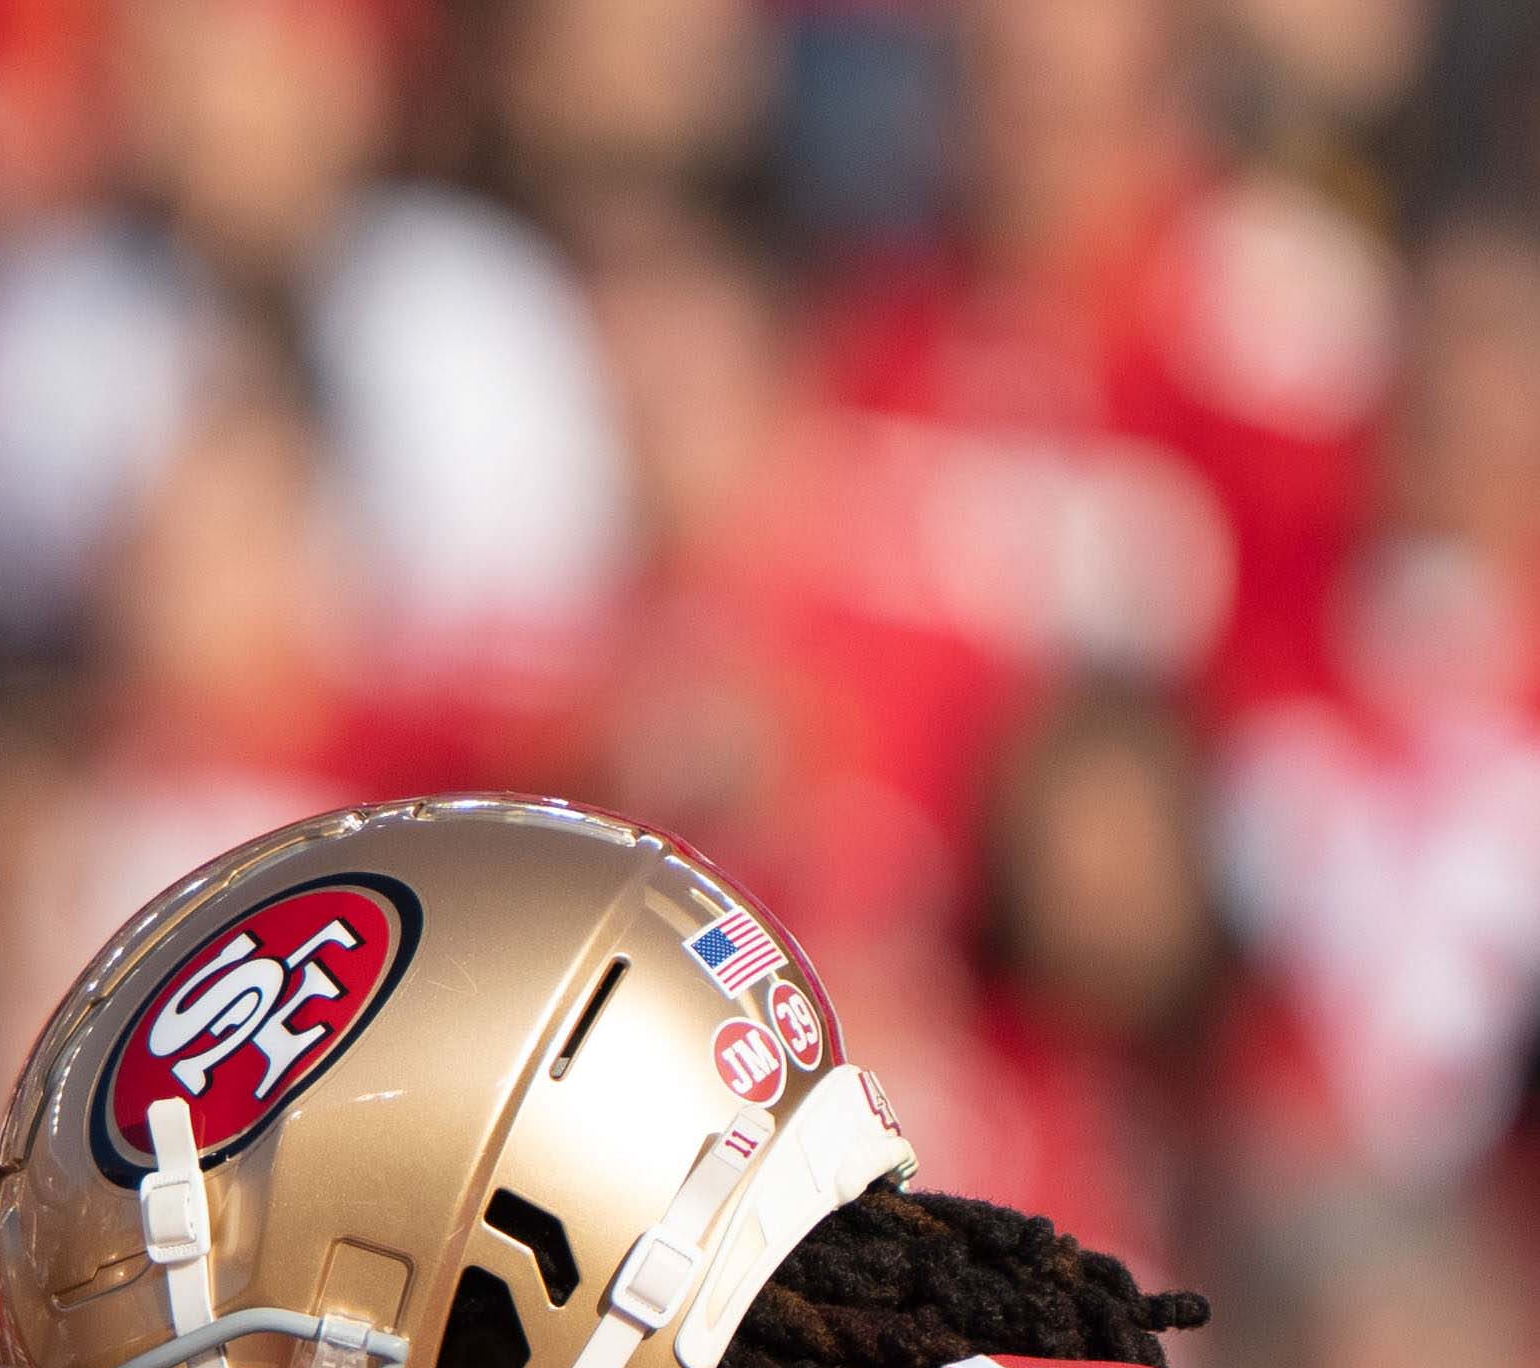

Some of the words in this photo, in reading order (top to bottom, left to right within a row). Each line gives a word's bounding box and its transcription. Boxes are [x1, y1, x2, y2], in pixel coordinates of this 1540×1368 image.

[147, 916, 365, 1101] SF
[776, 993, 819, 1053] 39
[722, 1029, 780, 1094] JM
